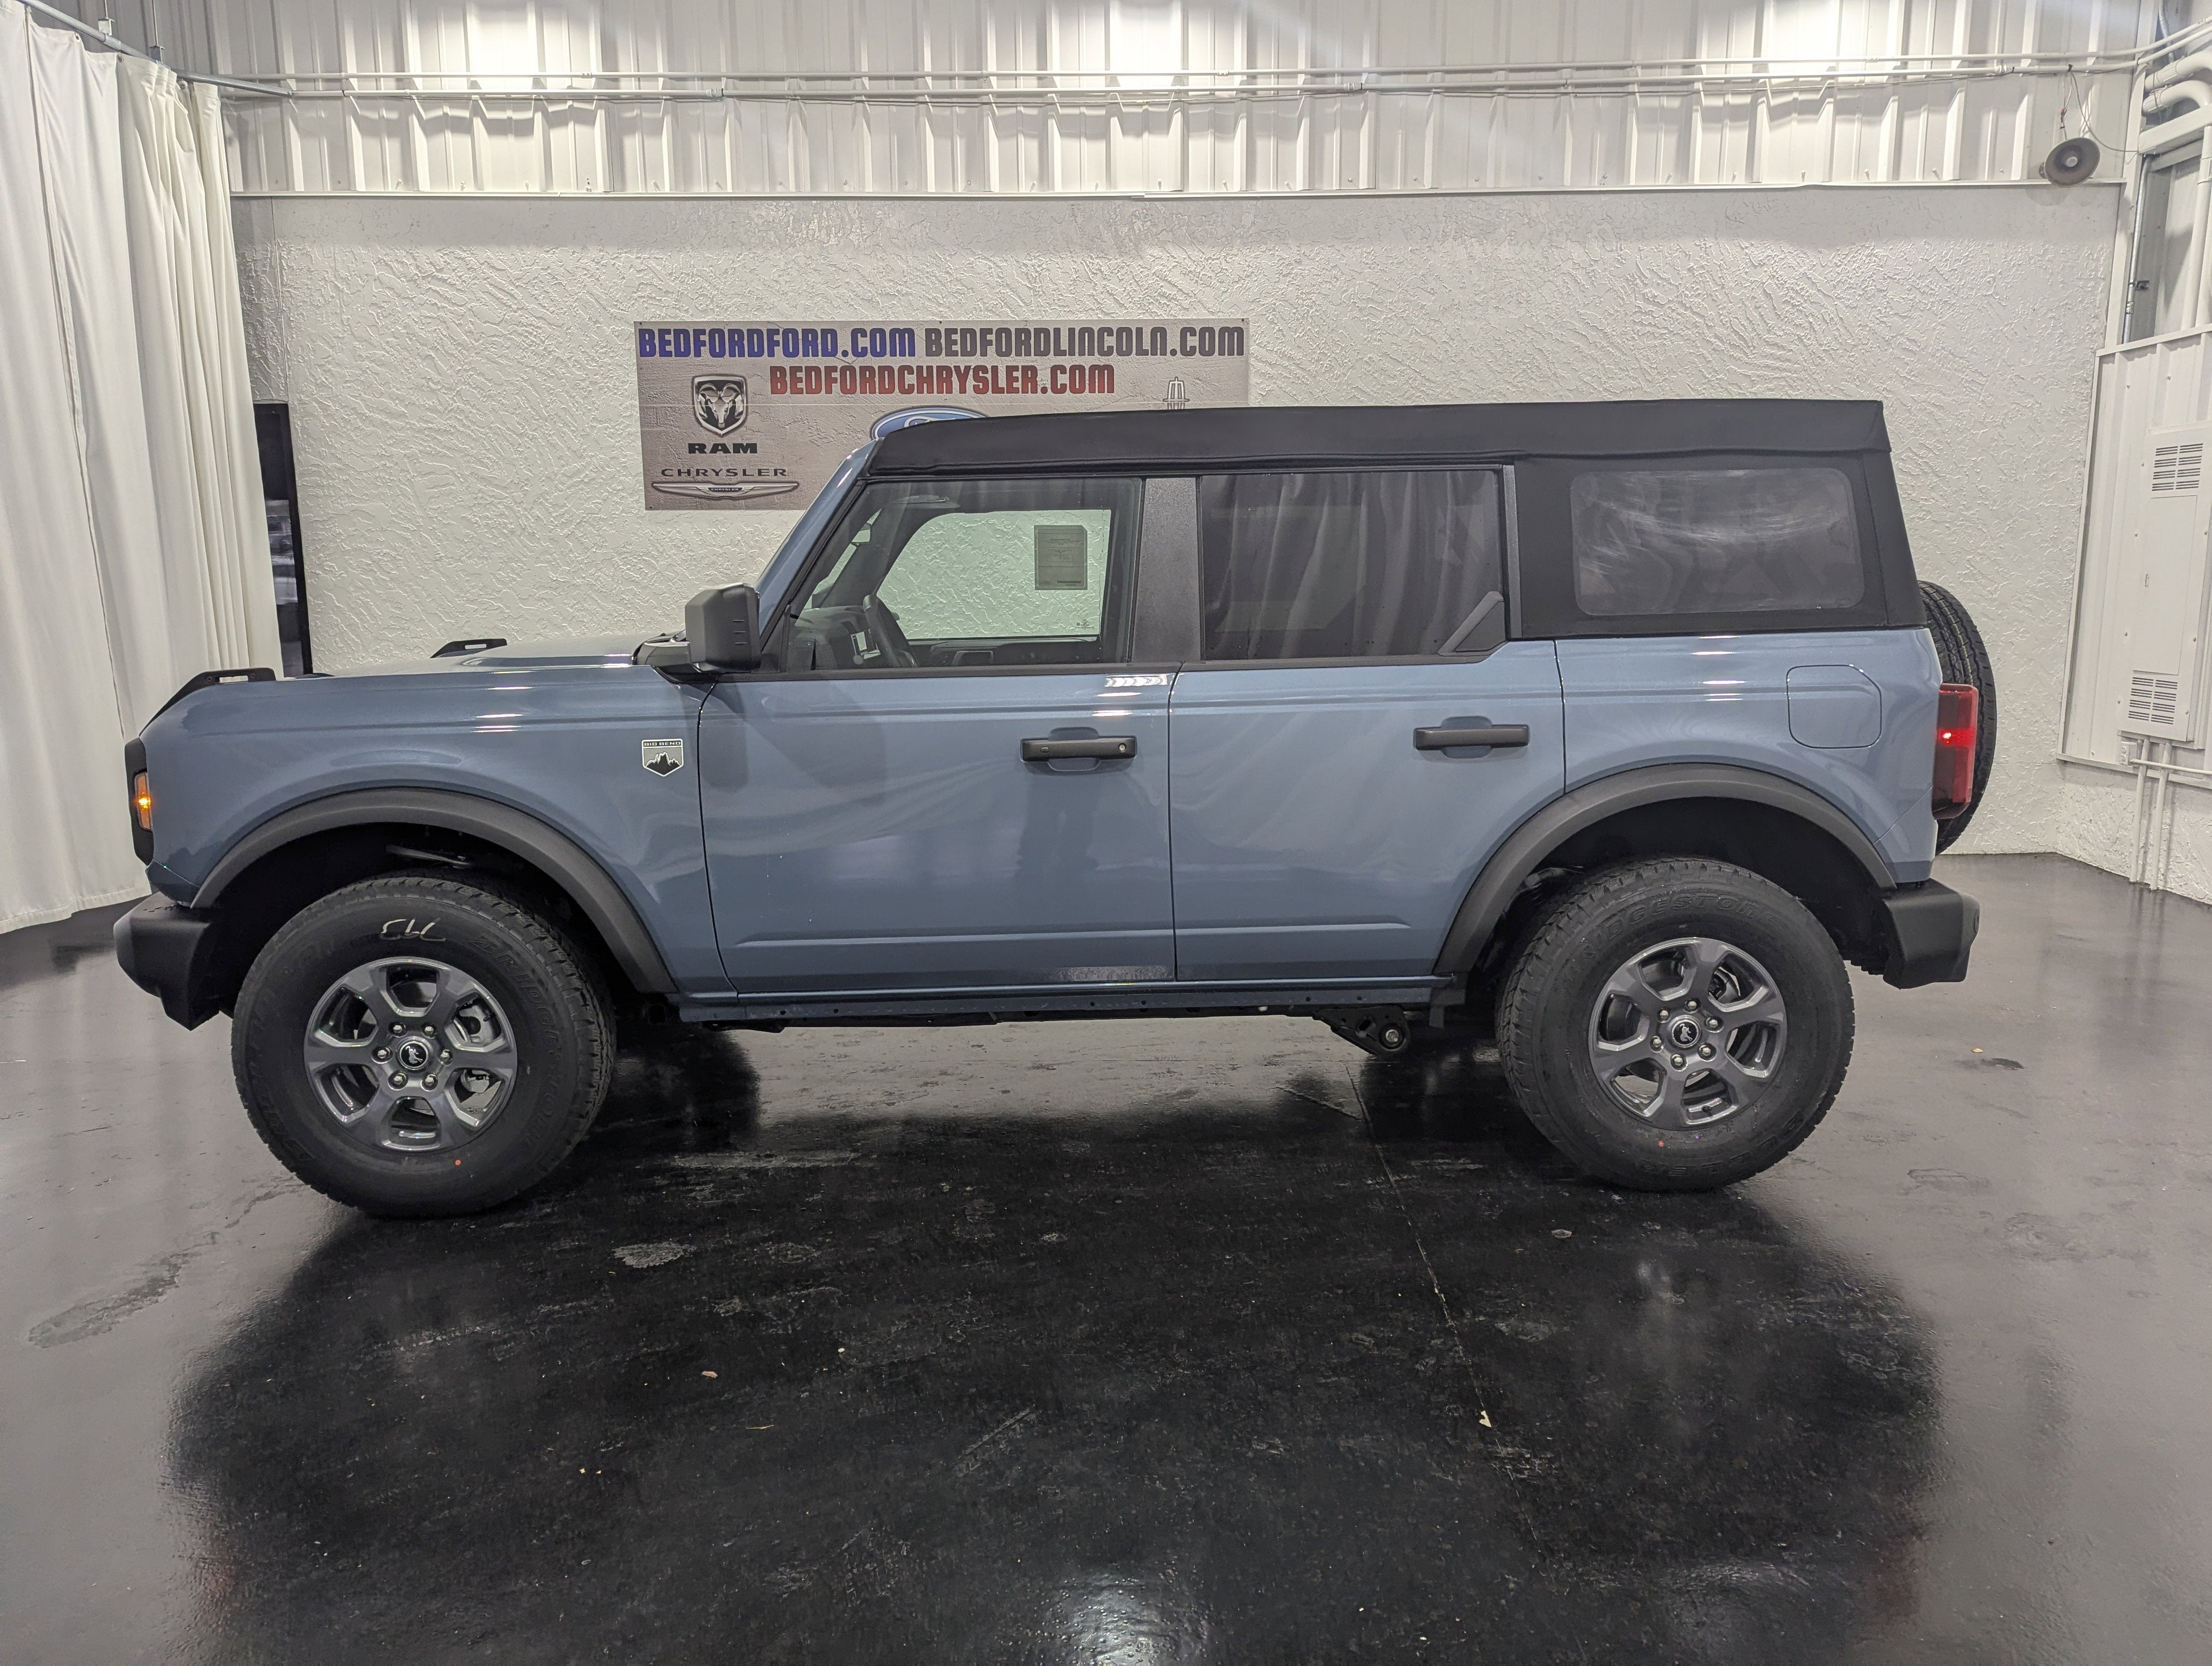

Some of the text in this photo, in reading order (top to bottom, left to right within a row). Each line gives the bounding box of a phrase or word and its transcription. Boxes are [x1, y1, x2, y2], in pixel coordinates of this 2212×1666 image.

[638, 326, 1244, 358] BEDFORDFORD.COM BEDFORDLINCOLN.COM
[769, 364, 1115, 395] BEDFORDCHRYSLER.COM
[687, 443, 758, 454] RAM
[661, 468, 787, 477] CHRYSLER
